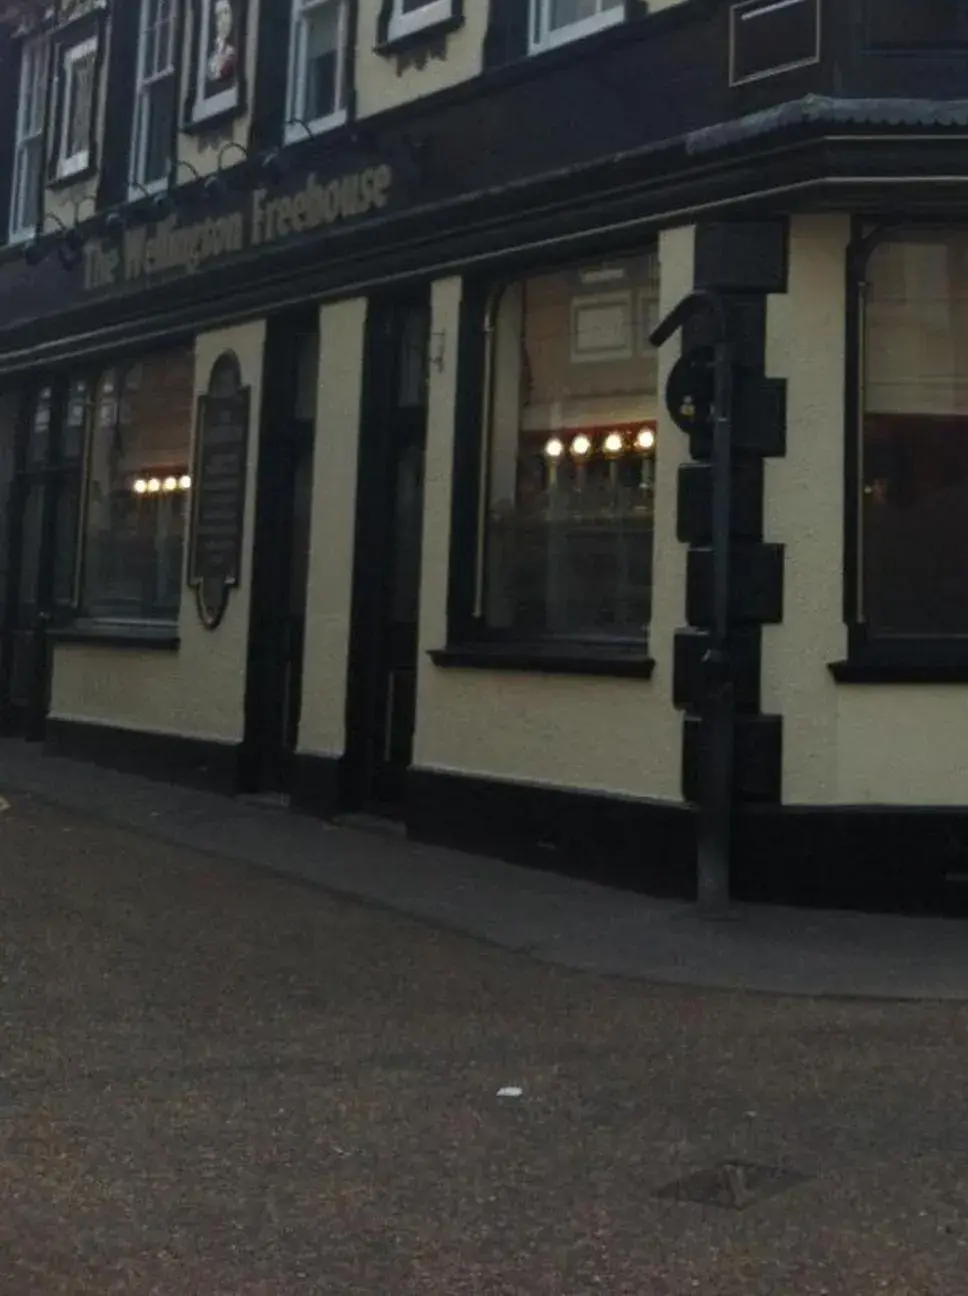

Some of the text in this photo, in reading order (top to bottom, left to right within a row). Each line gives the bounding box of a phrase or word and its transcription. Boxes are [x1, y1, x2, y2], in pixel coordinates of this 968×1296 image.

[83, 163, 392, 291] The Wellington Freehouse
